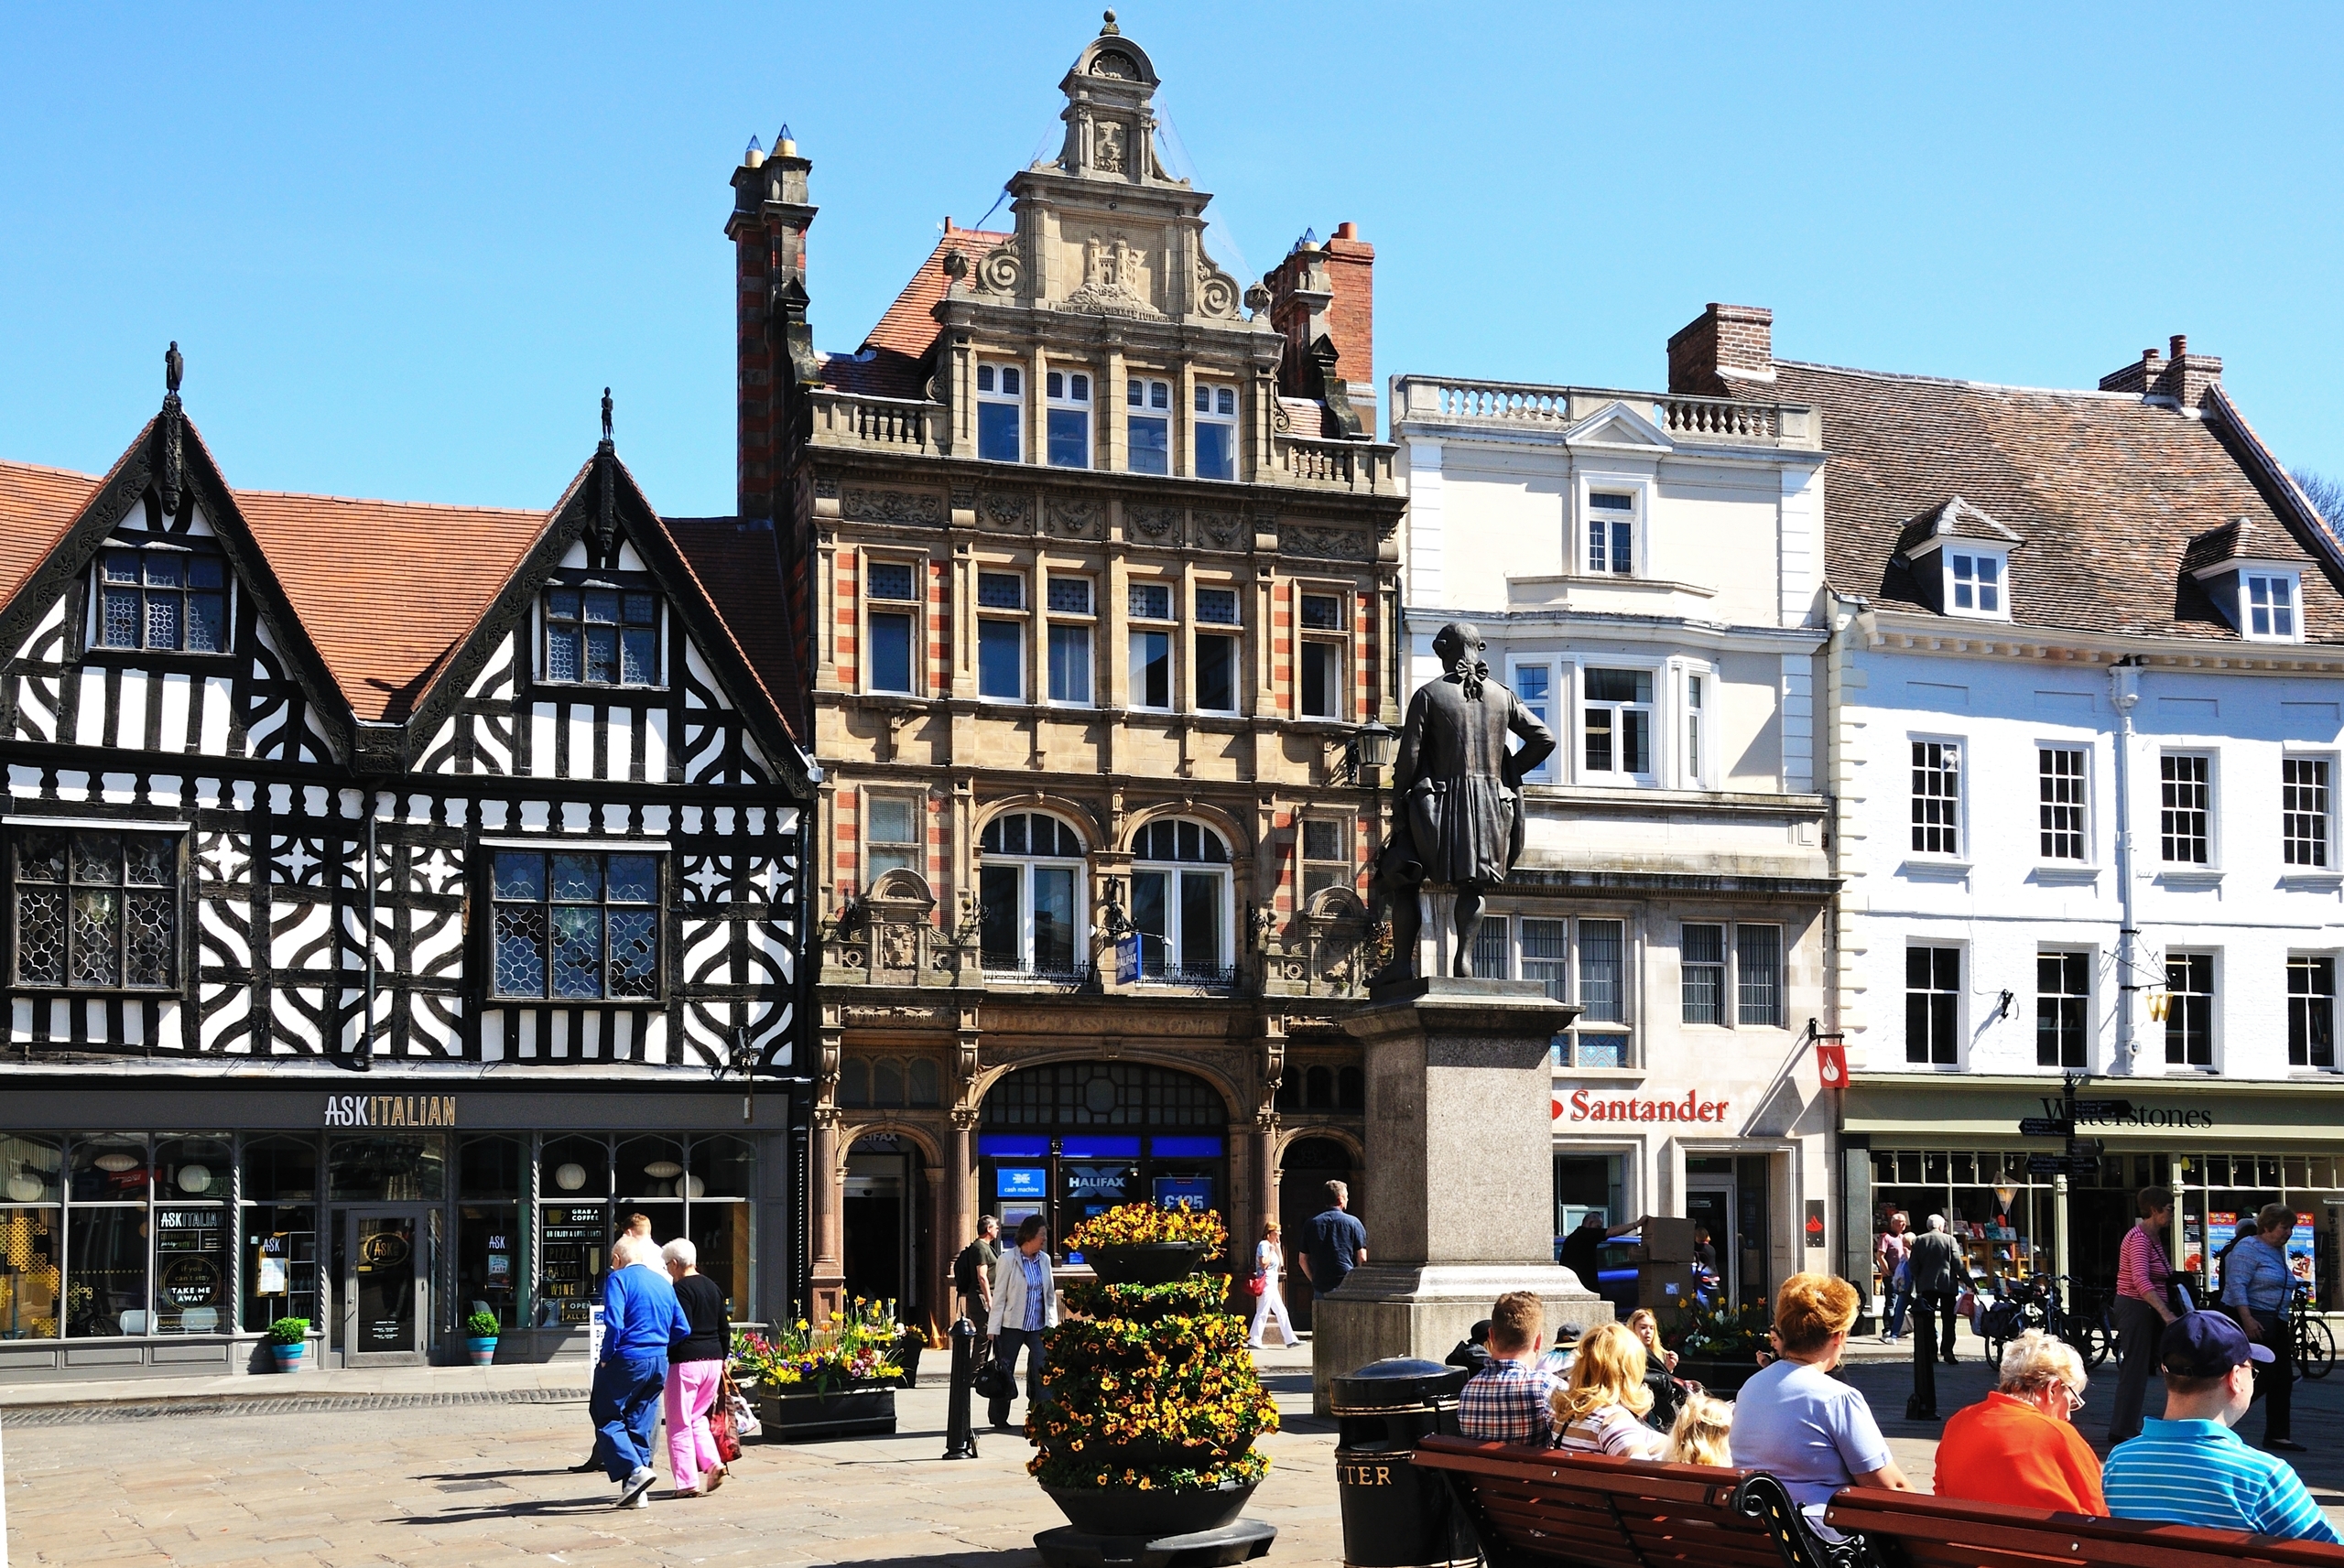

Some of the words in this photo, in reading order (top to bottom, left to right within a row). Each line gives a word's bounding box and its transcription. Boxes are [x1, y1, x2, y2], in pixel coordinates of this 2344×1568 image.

[1115, 953, 1136, 968] HALIFAX
[2144, 994, 2175, 1022] W
[1571, 1089, 1730, 1121] Santander
[2040, 1098, 2212, 1129] Wstones
[859, 1132, 899, 1142] LIFAX
[1069, 1177, 1125, 1187] HALIFAX
[262, 1238, 280, 1252] ASK
[374, 1242, 393, 1257] ASK
[488, 1236, 505, 1249] ASK
[549, 1248, 577, 1260] PIZZA
[548, 1265, 578, 1277] PASTA
[550, 1283, 575, 1295] WINE
[1337, 1465, 1392, 1485] TTER
